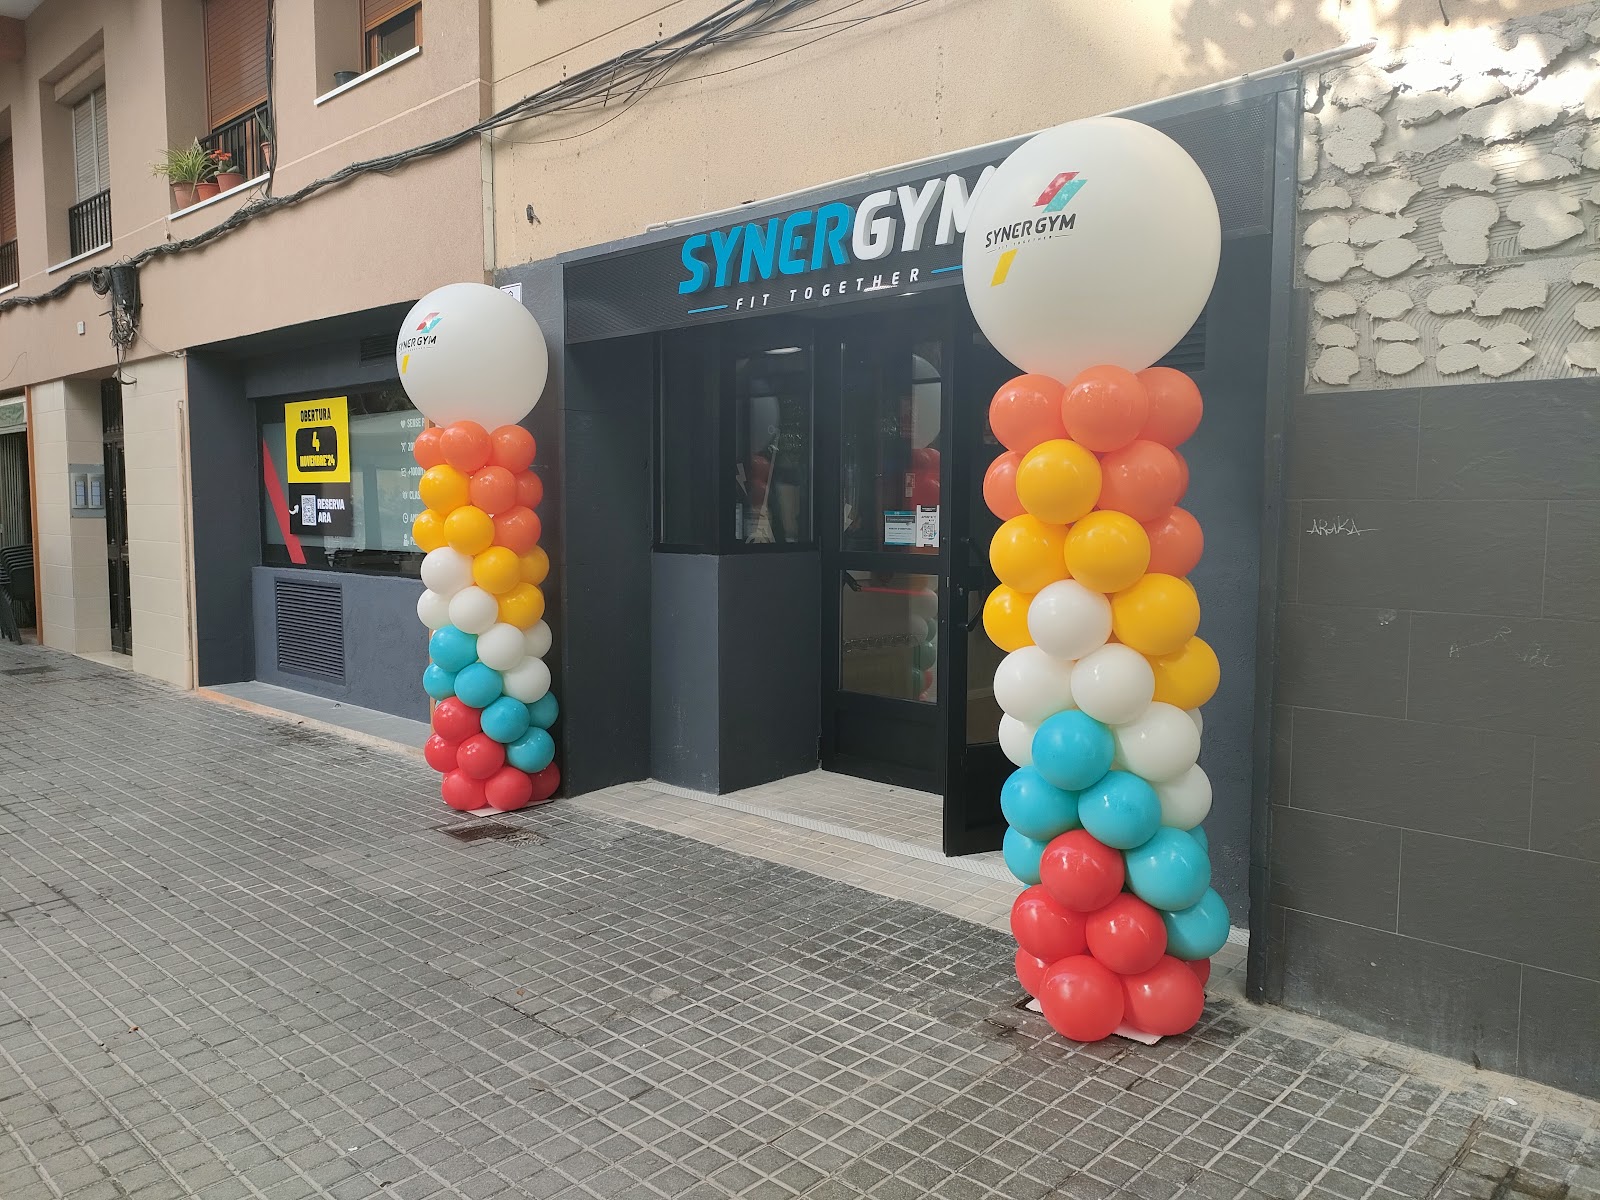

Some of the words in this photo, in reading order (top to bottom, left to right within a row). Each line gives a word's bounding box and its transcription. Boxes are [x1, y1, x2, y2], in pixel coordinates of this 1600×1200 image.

[678, 165, 998, 295] SYNERGYM
[985, 213, 1076, 248] SYNERGYM
[736, 294, 770, 310] FIT
[790, 268, 919, 302] TOGETHER
[300, 407, 332, 422] OBERTURA
[312, 431, 320, 452] 4
[317, 498, 345, 510] RESERVA
[317, 511, 332, 523] ARA
